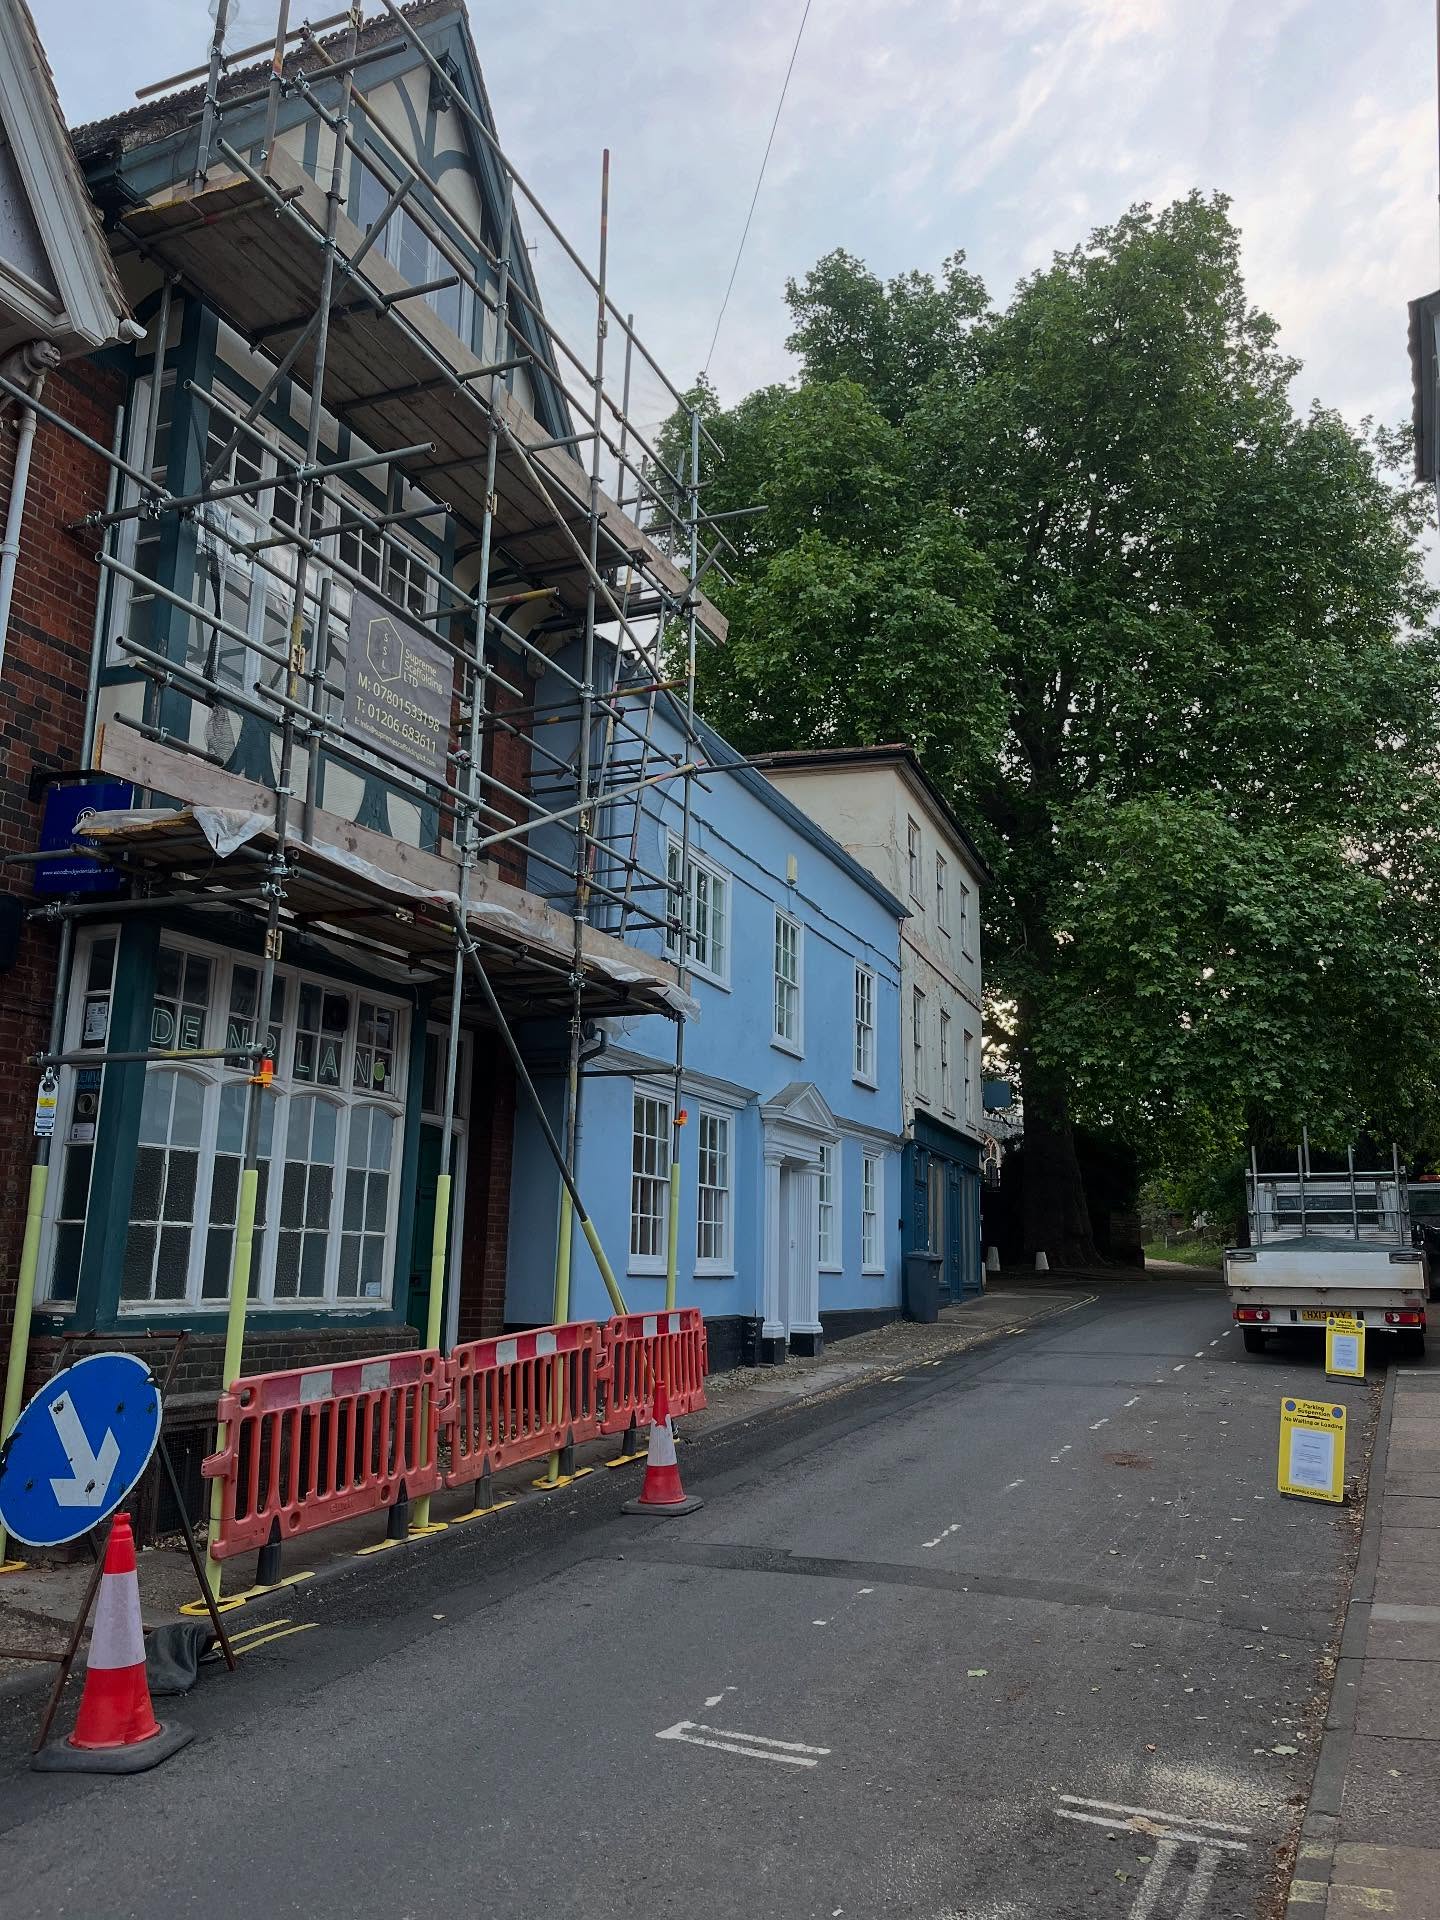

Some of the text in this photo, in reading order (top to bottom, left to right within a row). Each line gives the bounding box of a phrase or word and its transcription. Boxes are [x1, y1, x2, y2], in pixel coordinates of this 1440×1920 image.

[405, 648, 437, 677] Supreme
[403, 661, 443, 695] Scaffolding
[403, 671, 418, 688] LTD
[358, 671, 440, 733] M: 07801533198
[356, 695, 436, 755] T: 01206 683611
[1307, 1311, 1327, 1320] HX13
[1297, 1407, 1330, 1417] Suspension
[1302, 1402, 1325, 1412] Parking
[1293, 1417, 1314, 1426] Waiting
[1320, 1422, 1344, 1431] Loading
[1309, 1490, 1329, 1499] COUNCIL
